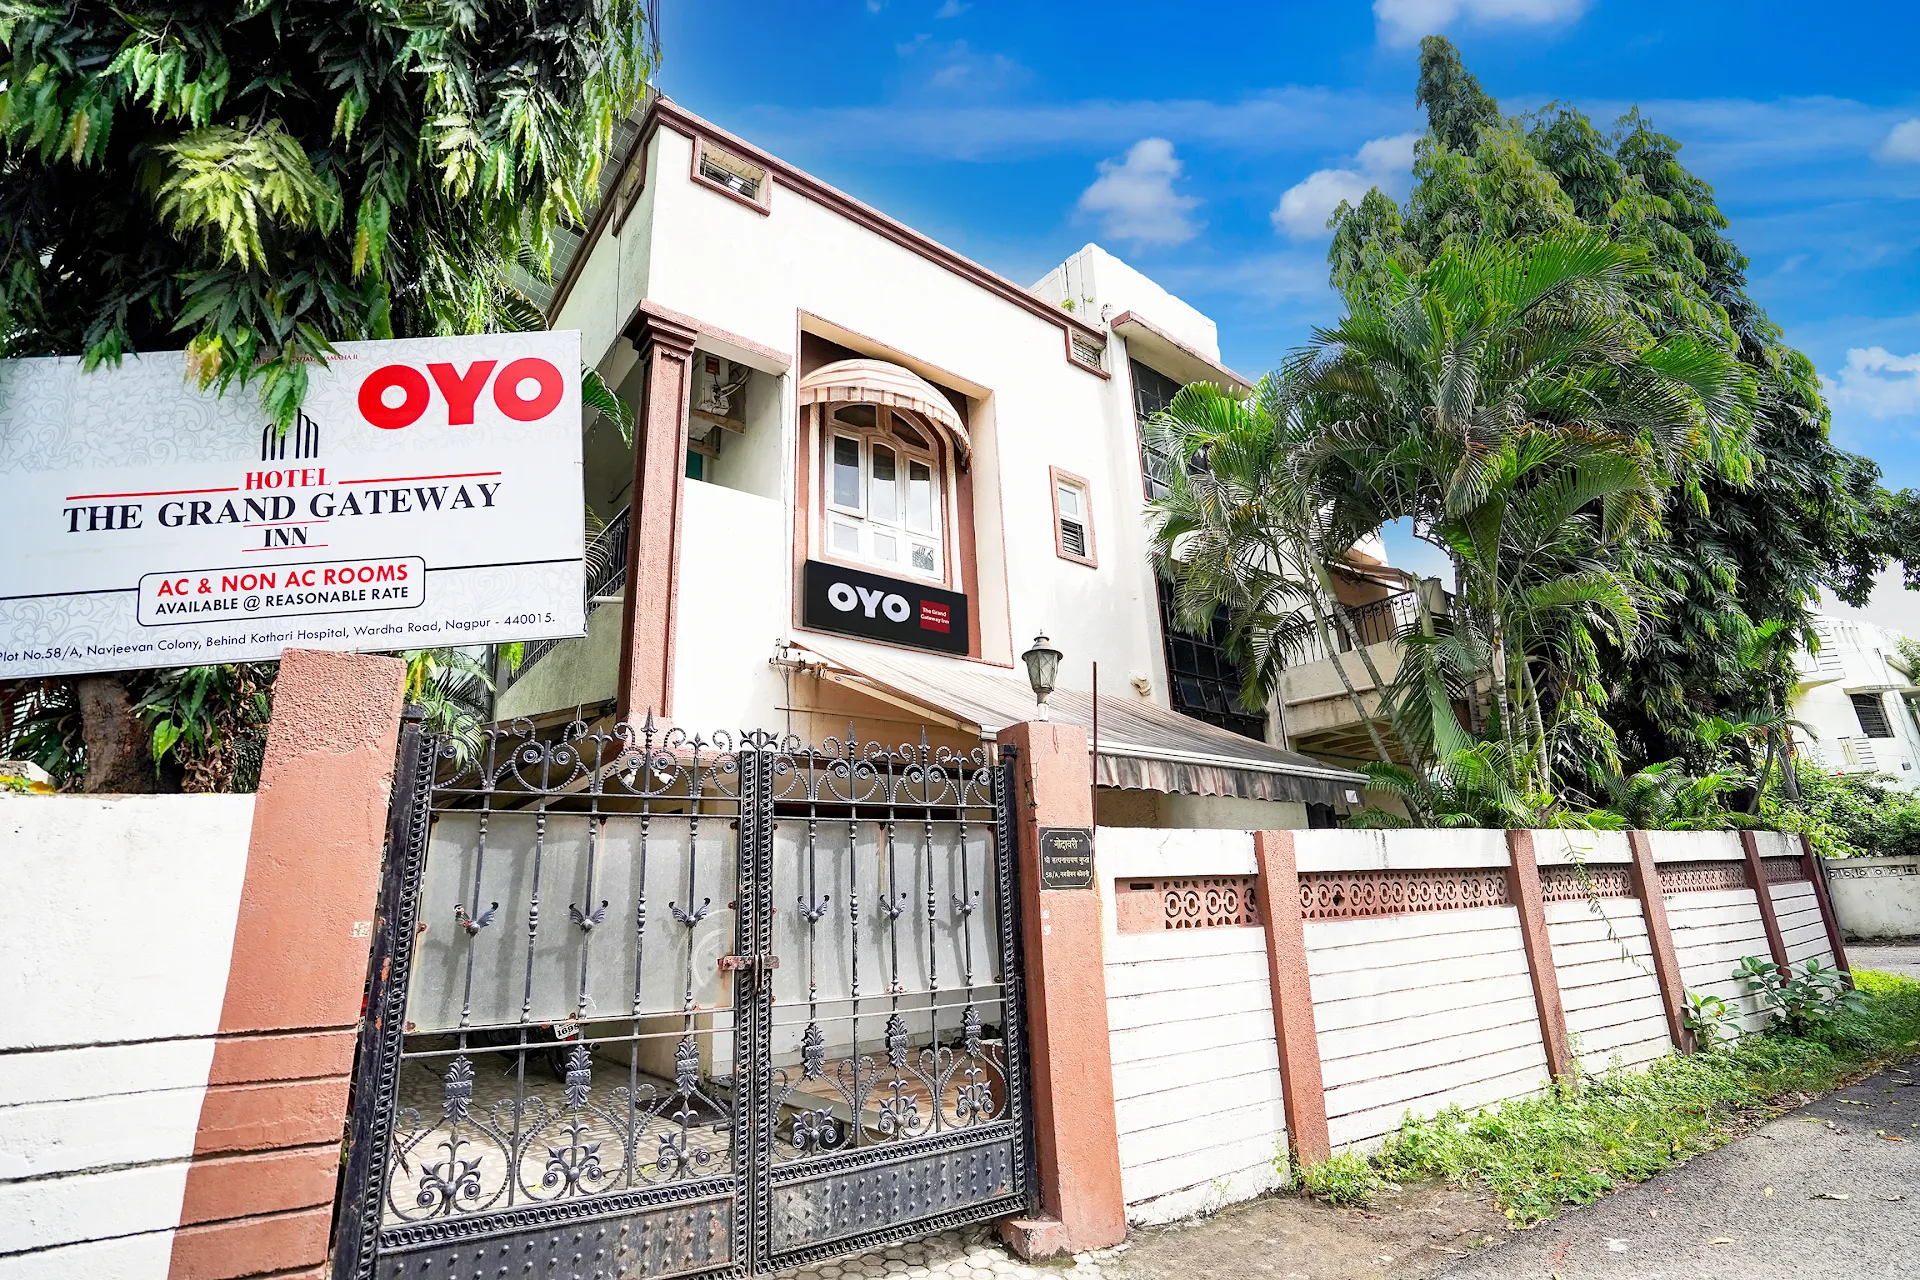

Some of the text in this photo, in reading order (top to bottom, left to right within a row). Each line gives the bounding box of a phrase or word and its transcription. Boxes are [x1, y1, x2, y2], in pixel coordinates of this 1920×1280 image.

[358, 357, 564, 430] OYO
[245, 468, 331, 490] HOTEL
[63, 483, 501, 533] THE GRAND GATEWAY
[264, 527, 308, 547] INN
[157, 564, 408, 597] AC & NON AC ROOMS
[155, 586, 408, 615] AVAILABLE @ REASONABLE RATE
[828, 582, 911, 623] OYO
[931, 609, 947, 617] Grand
[920, 614, 941, 624] Gateway
[0, 651, 19, 662] lot
[23, 645, 82, 661] No.58/A,
[87, 643, 153, 657] Navjeevan
[158, 638, 202, 652] Colony,
[206, 634, 245, 648] Behind
[251, 630, 293, 644] Kothari
[297, 626, 350, 641] Hospital,
[354, 623, 403, 637] Wardha
[408, 621, 441, 634] Road,
[445, 618, 491, 633] Nagpur
[504, 612, 555, 626] 440015.
